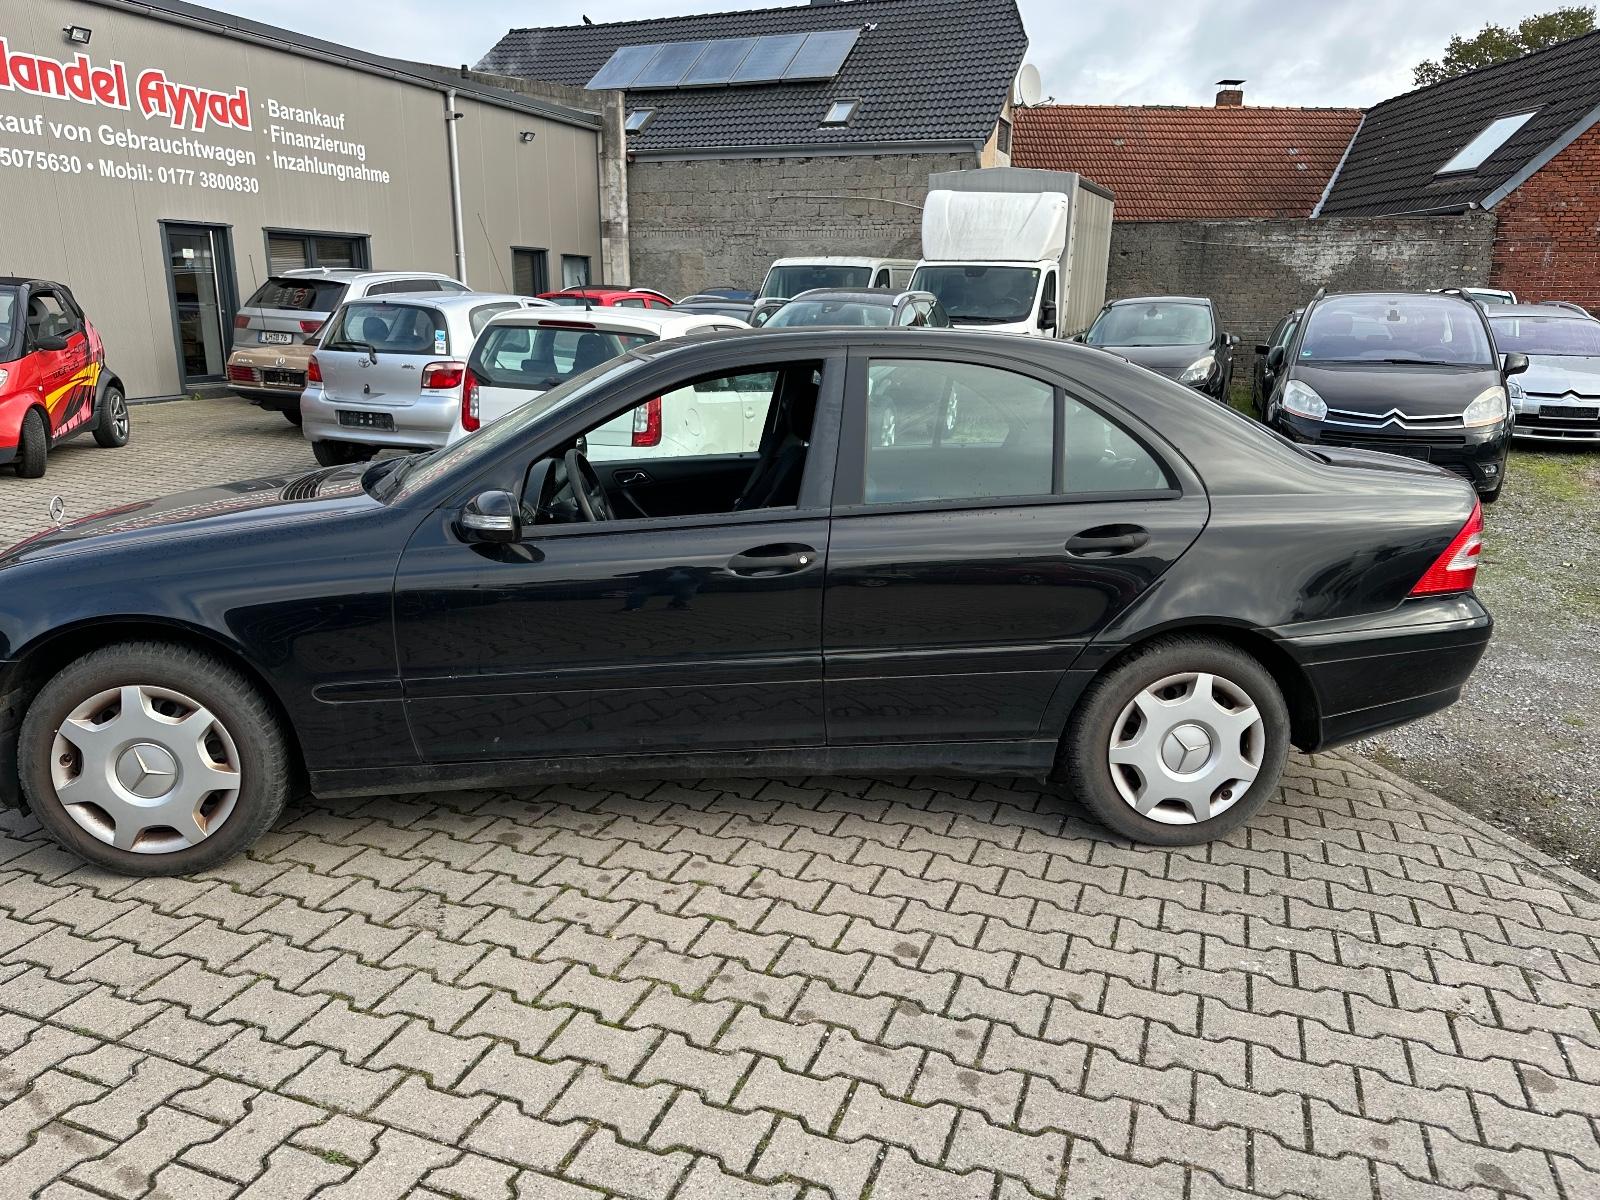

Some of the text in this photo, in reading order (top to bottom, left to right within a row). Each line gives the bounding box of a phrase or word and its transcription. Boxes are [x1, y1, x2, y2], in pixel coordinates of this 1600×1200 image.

[136, 68, 252, 133] Ayyad
[267, 98, 345, 130] Barankauf
[48, 121, 92, 143] von
[97, 124, 257, 167] Gebrauchtwagen
[270, 124, 366, 162] Finanzierung
[0, 147, 259, 194] 5075630 Mobil: 0177 3800830
[273, 150, 390, 184] Inzahlungnahme
